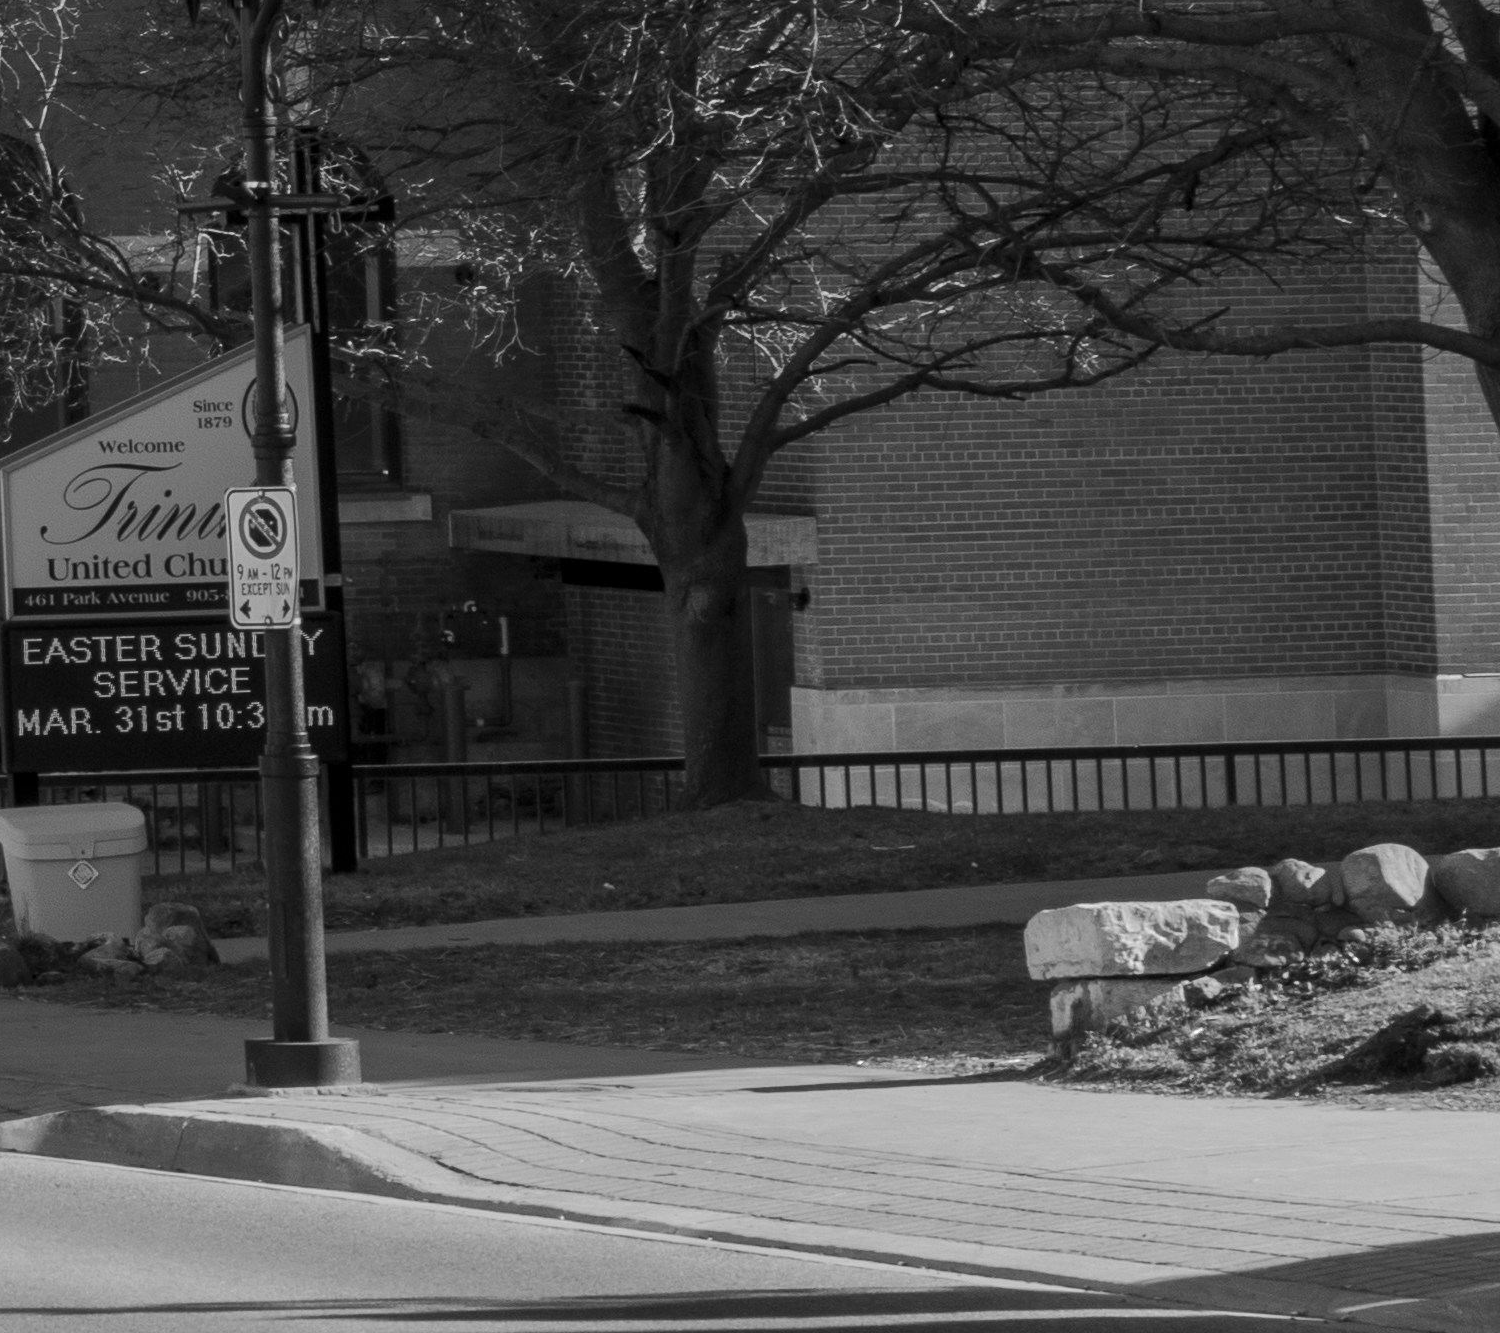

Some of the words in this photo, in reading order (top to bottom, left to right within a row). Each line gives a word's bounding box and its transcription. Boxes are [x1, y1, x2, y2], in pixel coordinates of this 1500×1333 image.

[192, 399, 234, 413] Since
[197, 416, 233, 429] 1879
[100, 439, 186, 454] Welcome
[48, 553, 151, 581] United
[164, 552, 230, 579] Chu
[237, 564, 244, 580] 9
[247, 567, 259, 580] AM
[270, 563, 281, 580] 12
[284, 567, 293, 580] PM
[241, 582, 272, 596] EXCEPT
[276, 582, 290, 595] SUN
[25, 592, 55, 607] 461
[62, 591, 101, 606] Park
[106, 590, 170, 605] Avenue
[22, 634, 163, 665] EASTER
[174, 628, 324, 661] SUNDY
[93, 667, 251, 699] SERVICE
[17, 707, 101, 736] MAR.
[115, 704, 186, 733] 31st
